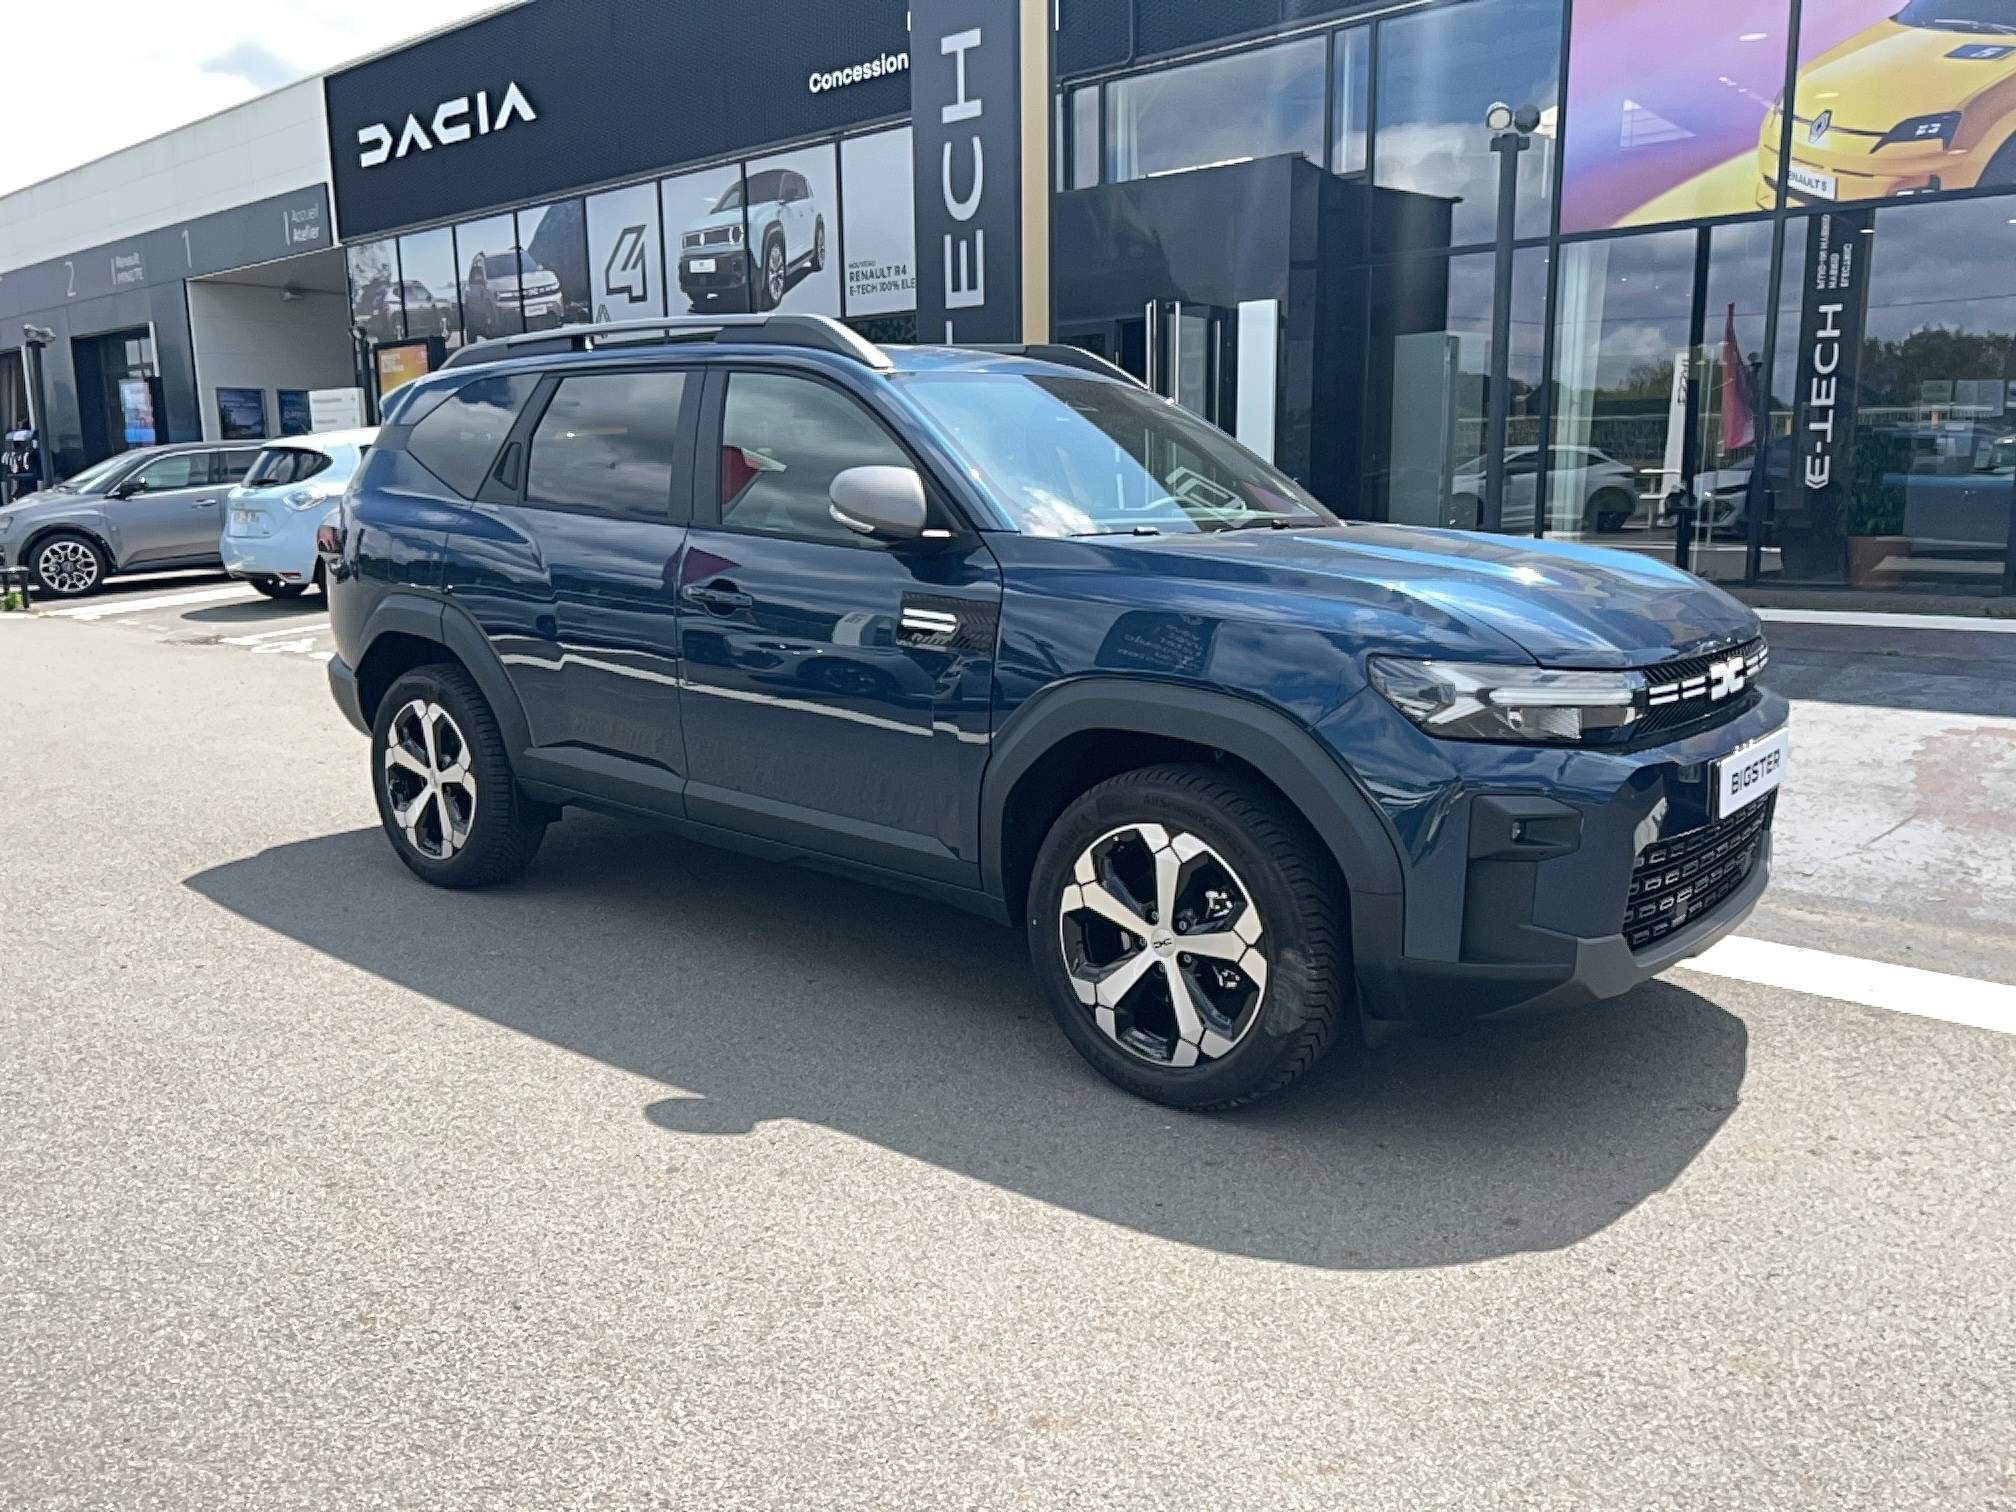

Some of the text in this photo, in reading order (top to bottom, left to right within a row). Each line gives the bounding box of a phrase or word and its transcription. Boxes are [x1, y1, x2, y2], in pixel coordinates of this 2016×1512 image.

[809, 52, 909, 93] Concession
[358, 81, 537, 168] DACIA
[1786, 171, 1820, 189] ENAULT
[65, 261, 76, 297] 2
[605, 225, 647, 303] 4
[850, 267, 892, 282] RENAULT
[849, 284, 877, 296] E-TECH
[880, 281, 899, 291] 100%
[1731, 749, 1780, 795] BIGSTER
